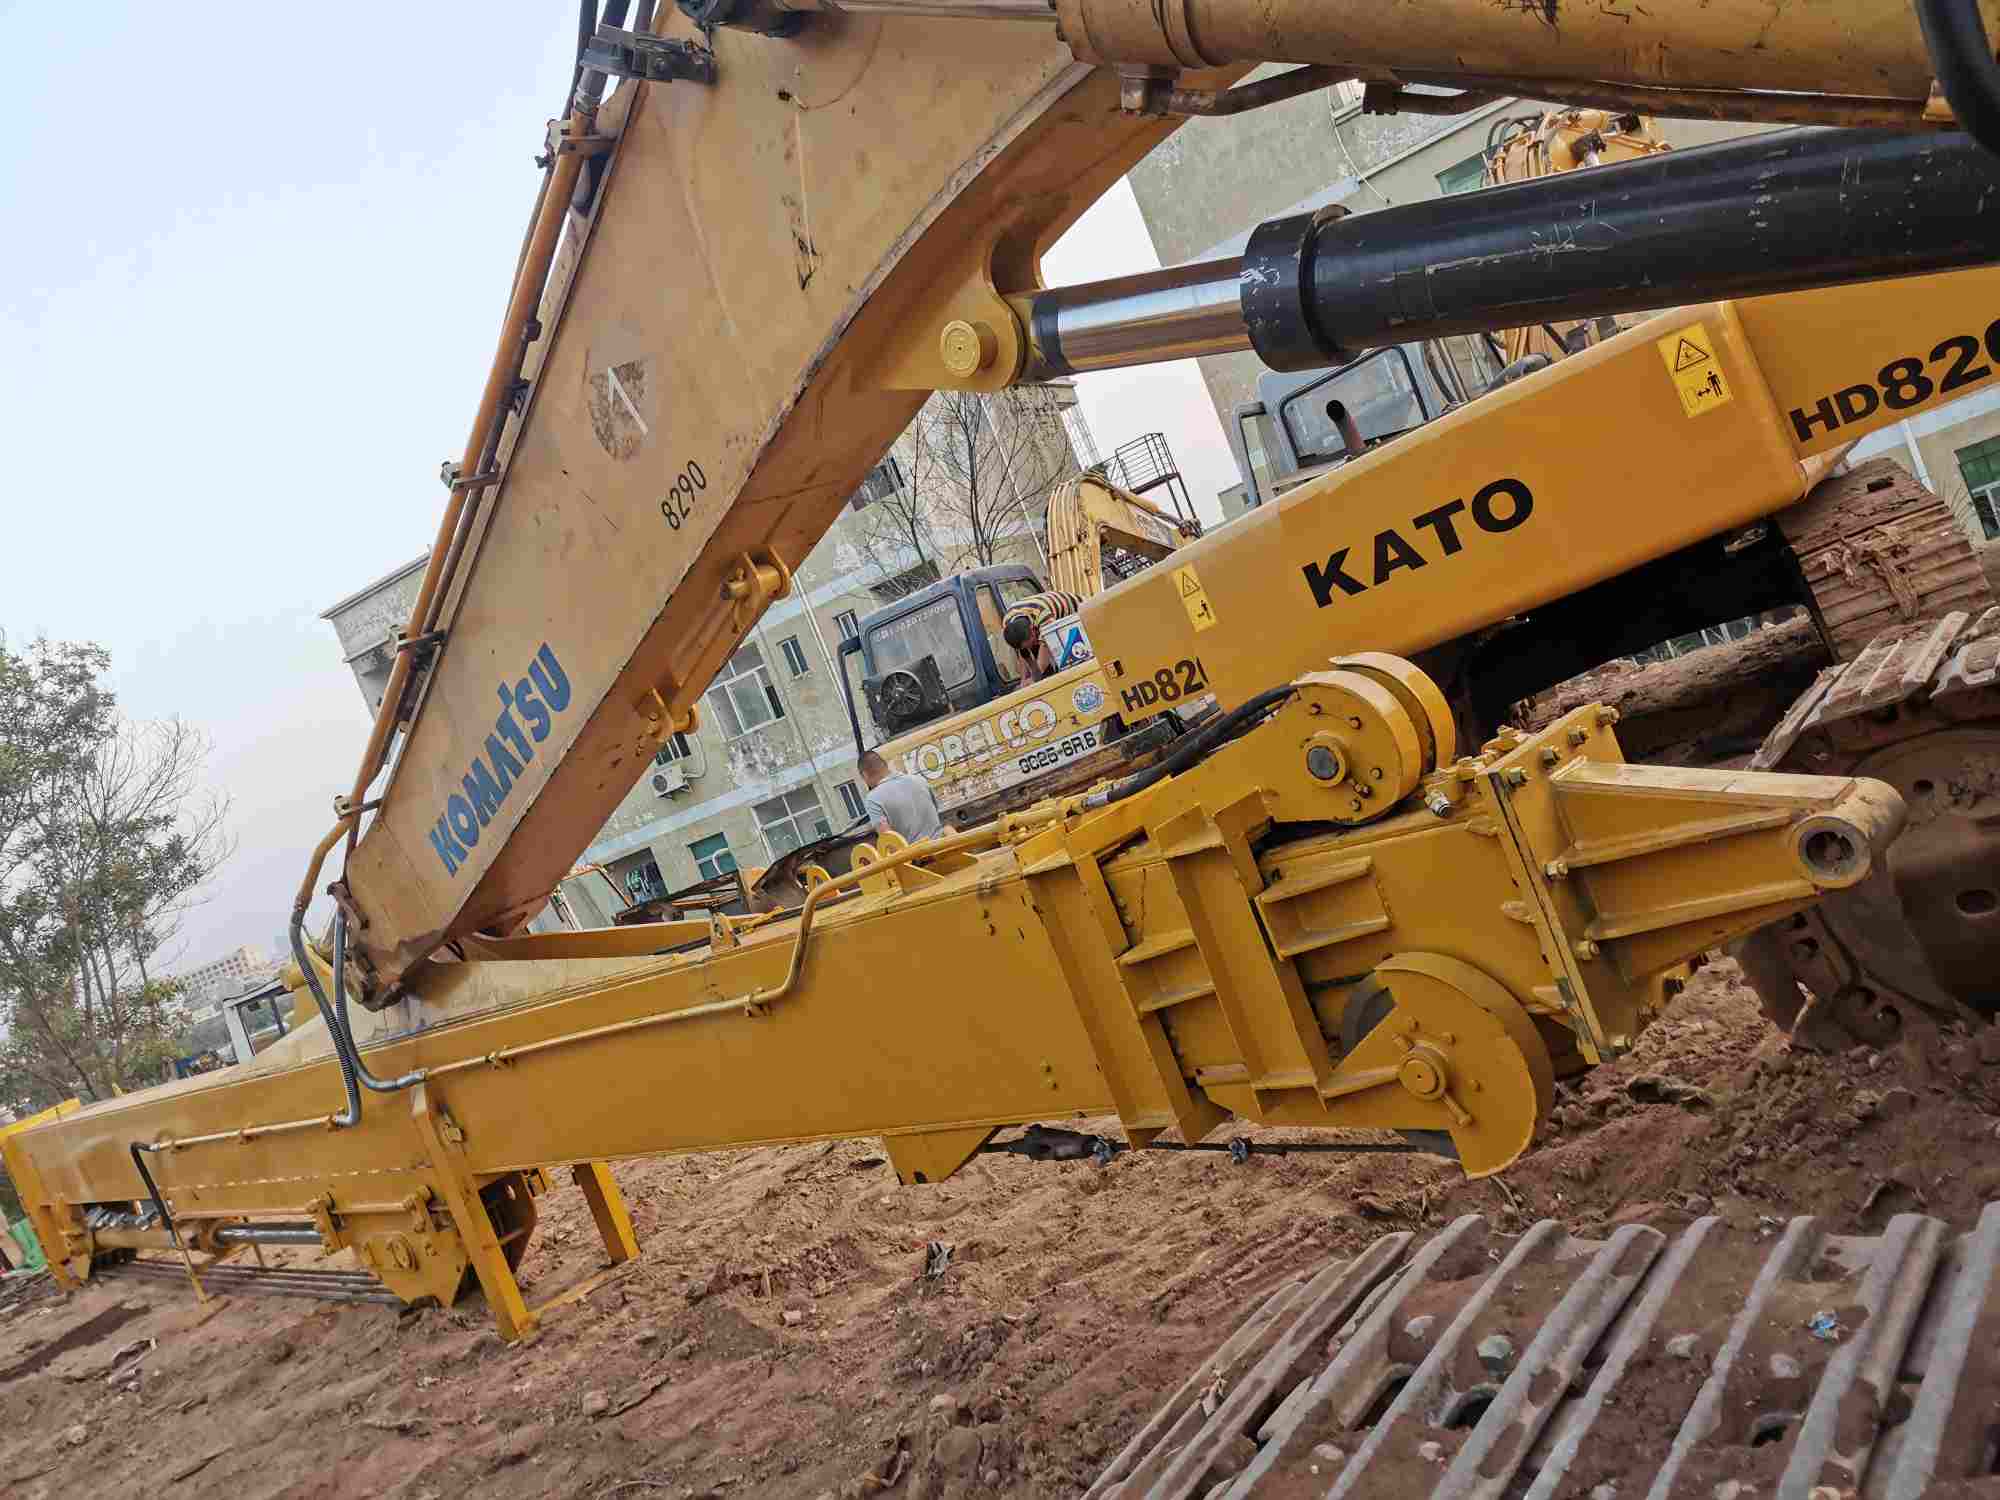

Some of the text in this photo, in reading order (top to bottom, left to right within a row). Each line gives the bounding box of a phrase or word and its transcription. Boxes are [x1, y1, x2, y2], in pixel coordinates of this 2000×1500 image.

[661, 460, 706, 530] 8290
[1302, 478, 1534, 608] KATO
[1119, 656, 1209, 713] HD82
[429, 641, 572, 877] KOMATSU
